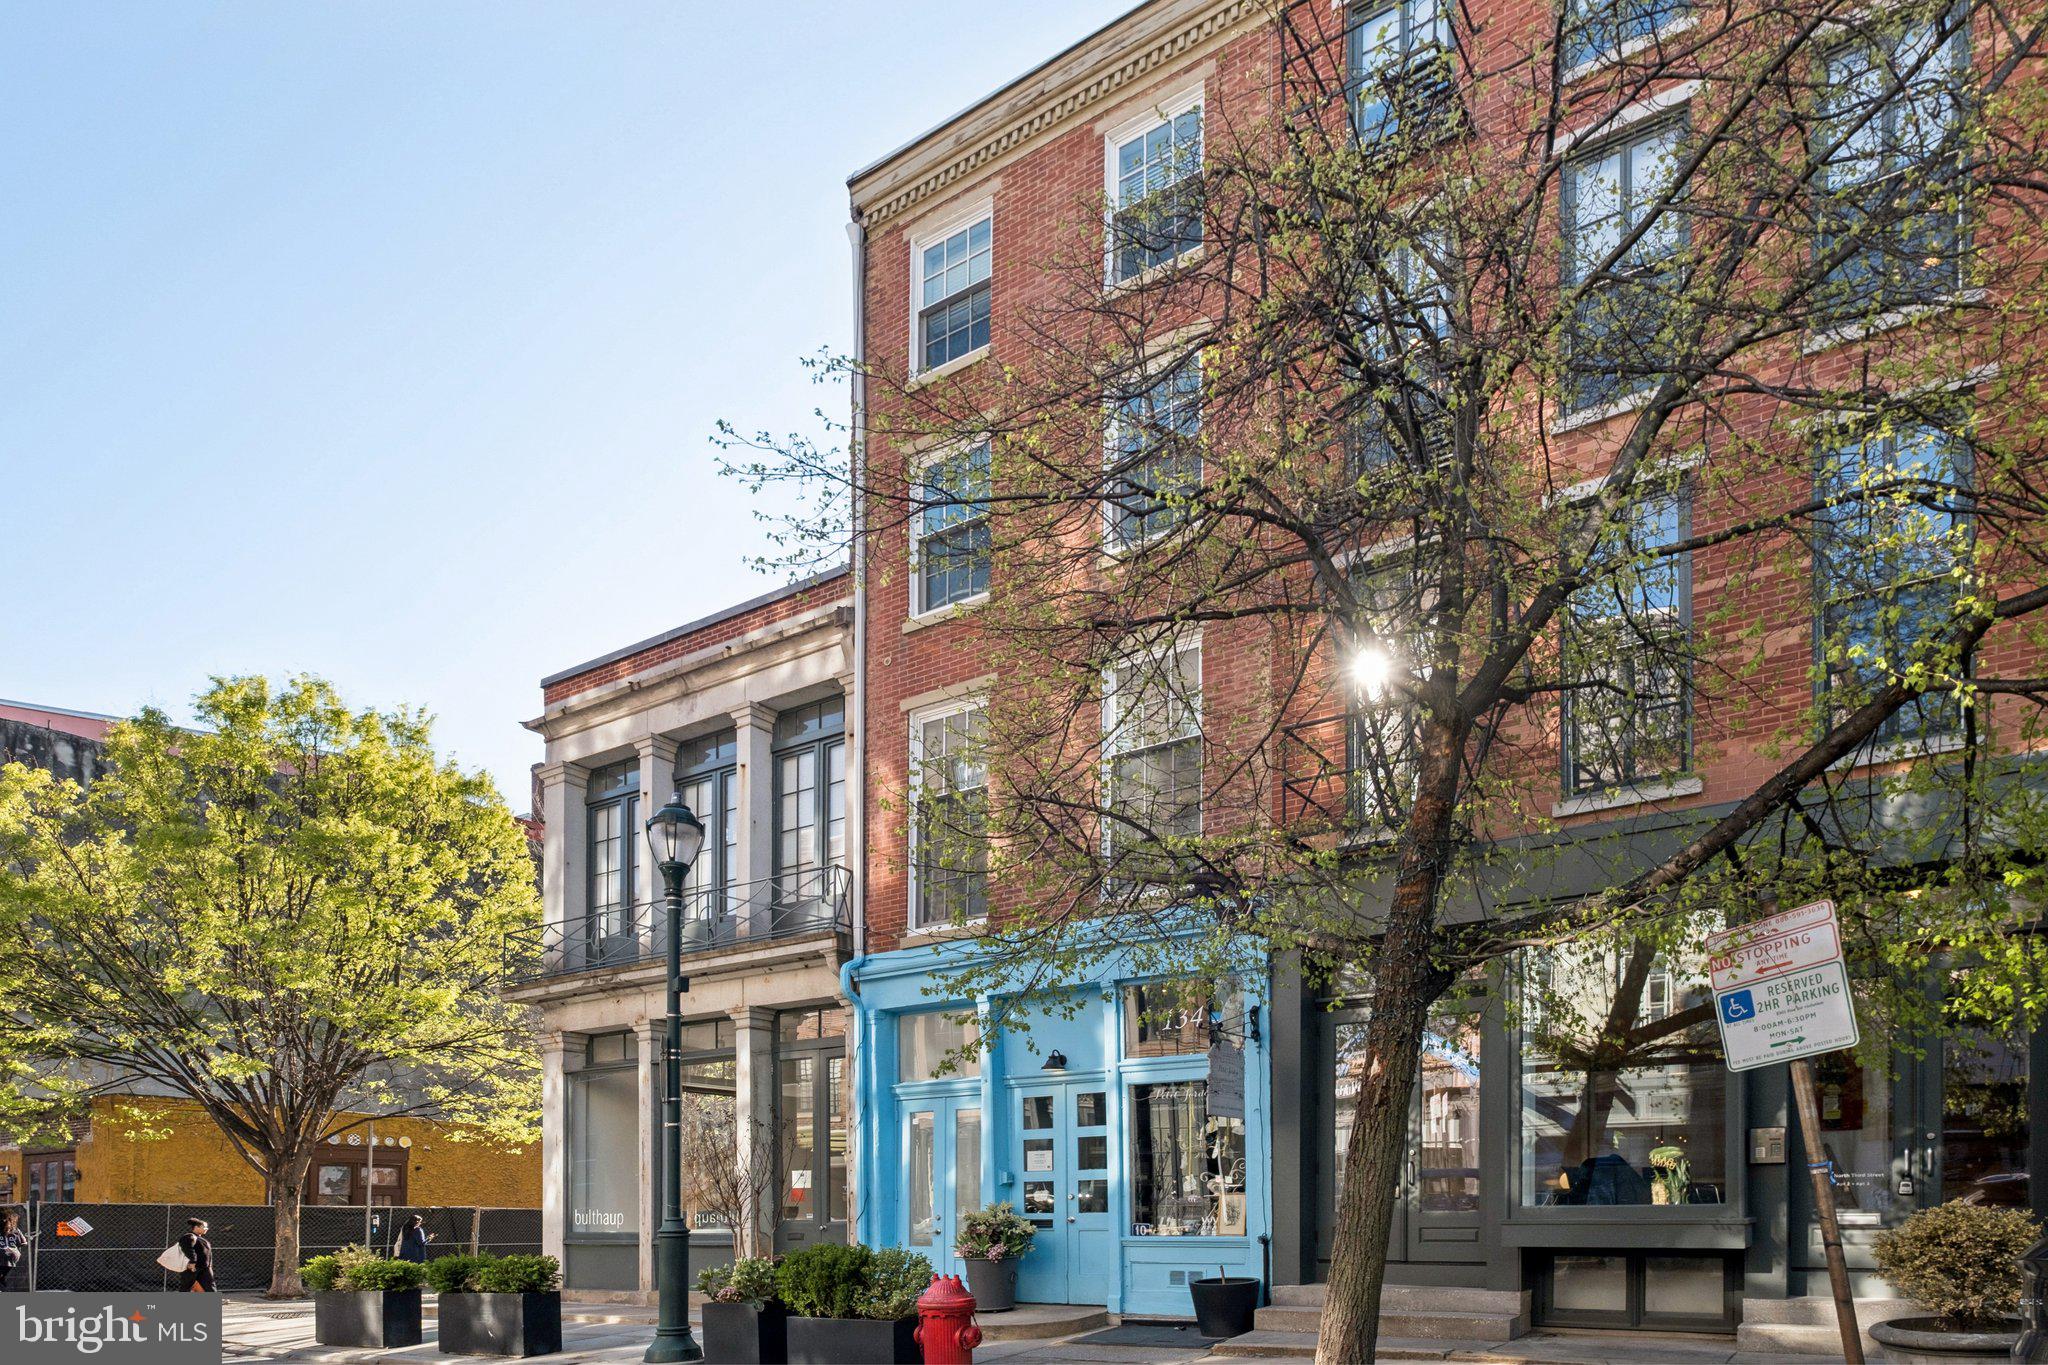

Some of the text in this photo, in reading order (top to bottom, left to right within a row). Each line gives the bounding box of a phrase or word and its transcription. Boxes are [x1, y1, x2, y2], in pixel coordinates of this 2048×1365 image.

[1711, 933, 1811, 971] NO STOPPING
[1755, 952, 1788, 966] ANY TIME
[1767, 973, 1823, 996] RESERVED
[1757, 998, 1780, 1013] 2HR
[1785, 982, 1840, 1006] PARKING
[1753, 1012, 1817, 1032] 8:00AM-6:30PM
[1769, 1026, 1804, 1039] MON-SAT
[1813, 1039, 1832, 1047] POSTED
[574, 1209, 624, 1228] bulthaup
